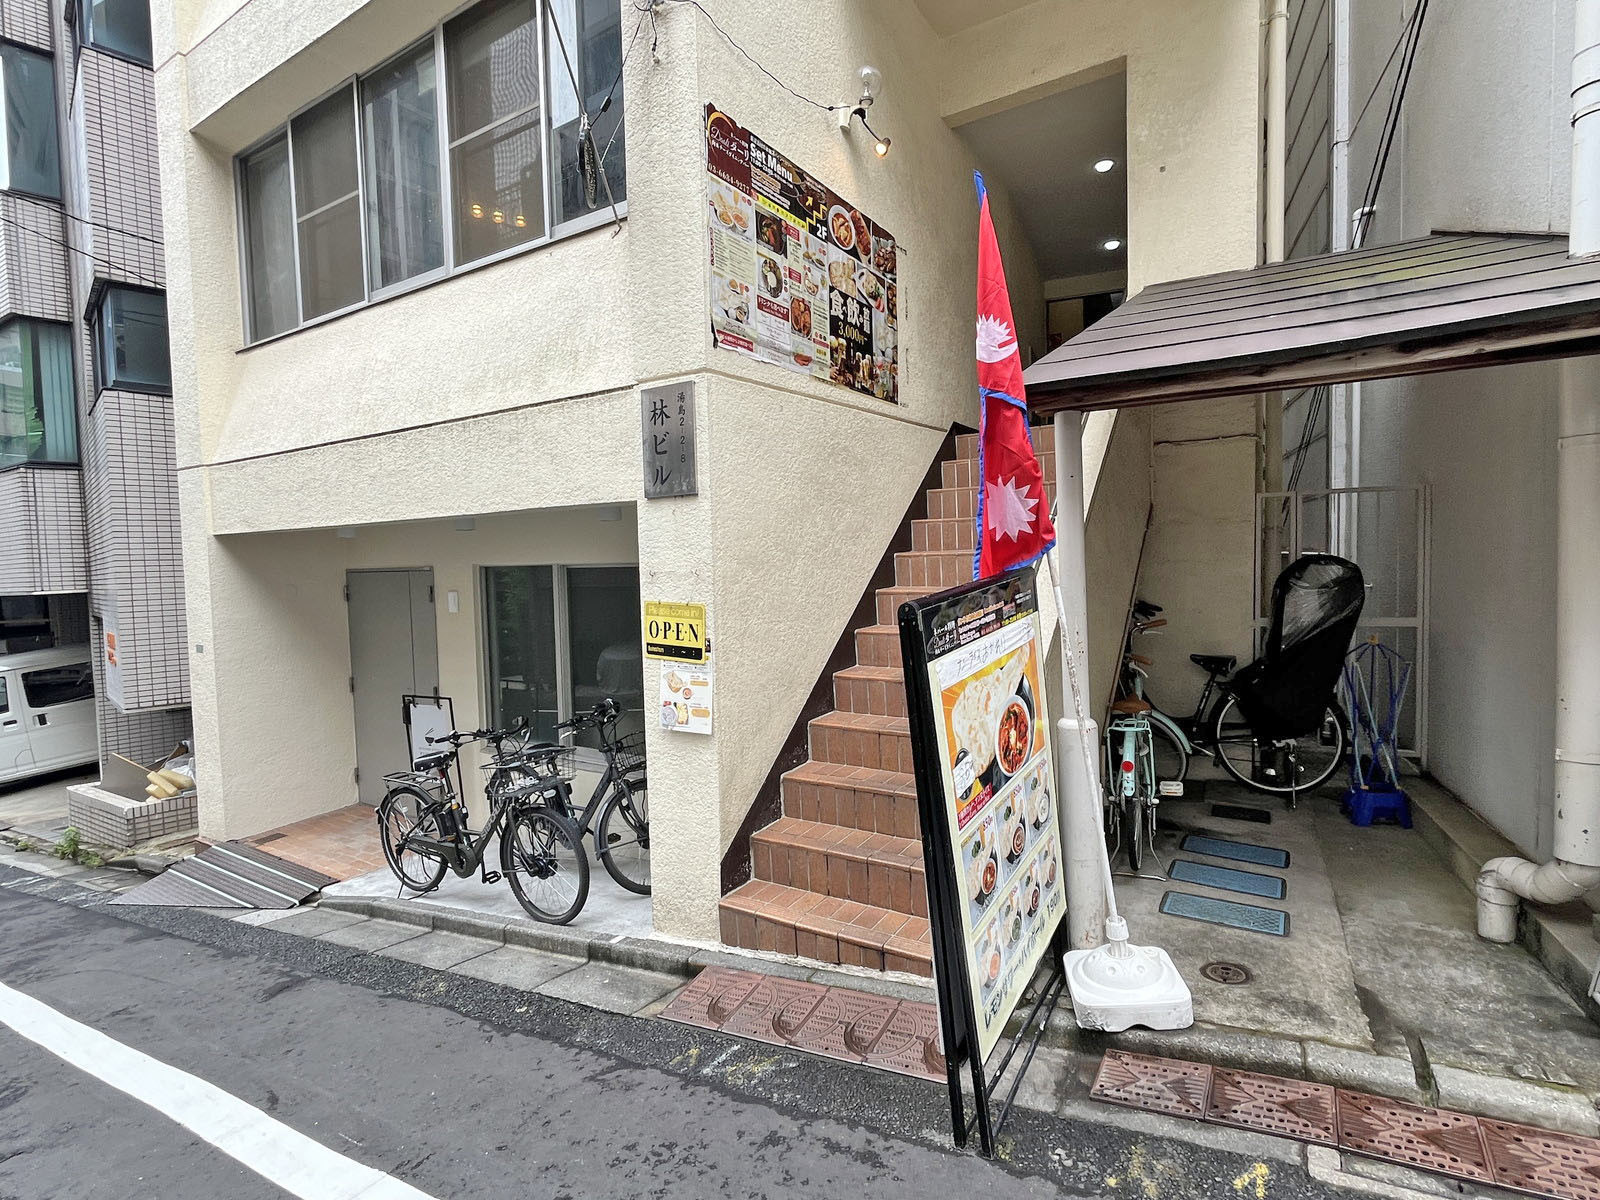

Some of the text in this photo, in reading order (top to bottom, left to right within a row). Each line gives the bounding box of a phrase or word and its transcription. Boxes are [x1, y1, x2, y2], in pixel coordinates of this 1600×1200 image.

[749, 142, 767, 166] Set
[767, 153, 793, 182] Menu
[816, 222, 828, 240] 2F
[649, 397, 673, 487] 林ビル
[670, 607, 690, 617] come
